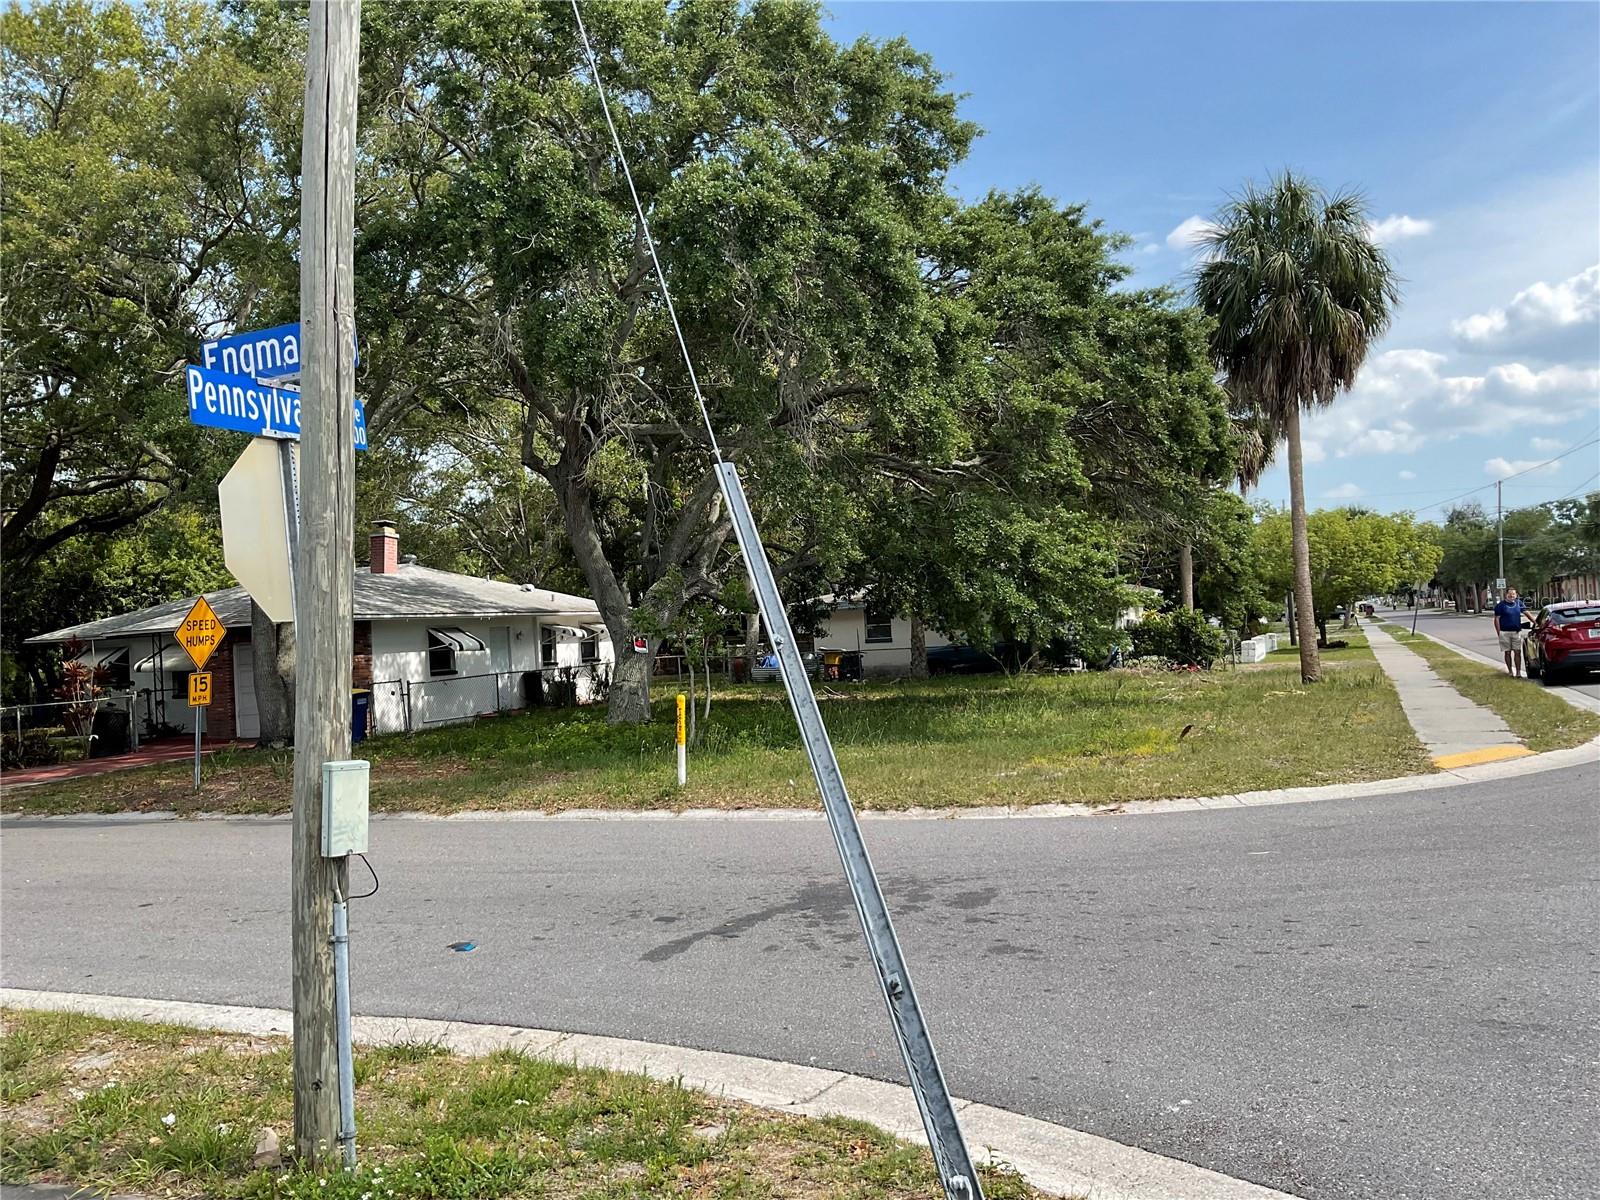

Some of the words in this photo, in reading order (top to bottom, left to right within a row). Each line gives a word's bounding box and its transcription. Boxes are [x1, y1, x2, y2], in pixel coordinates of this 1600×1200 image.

[203, 334, 299, 379] Engma
[188, 368, 300, 430] Pennsylva
[186, 619, 216, 632] SPEED
[186, 634, 215, 648] HUMPS
[193, 676, 208, 693] 15
